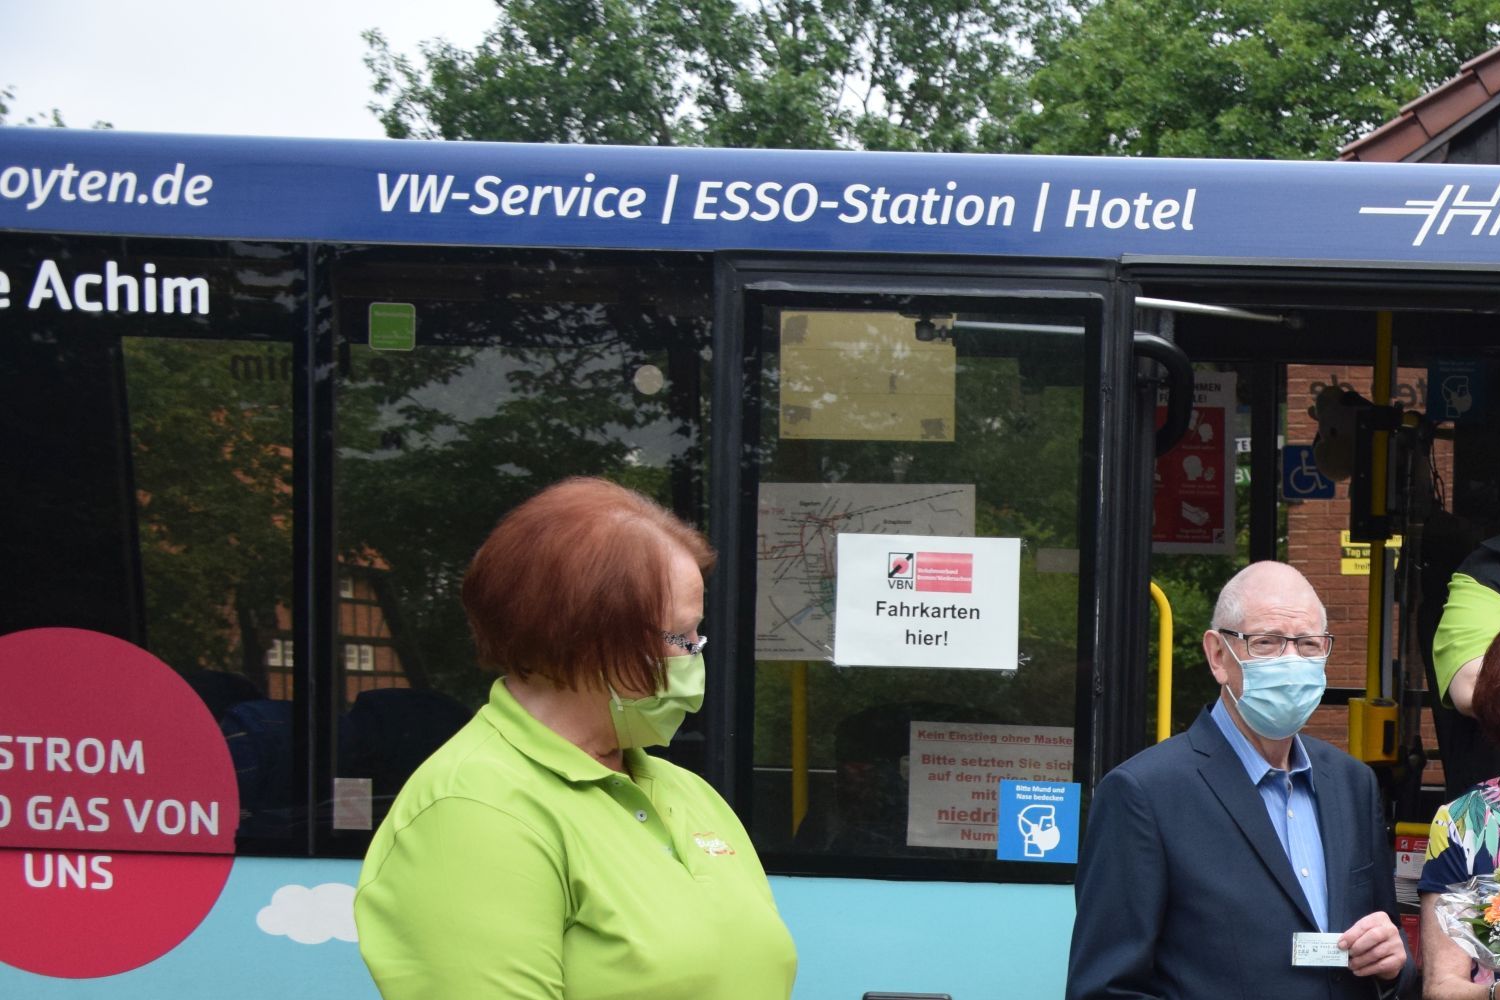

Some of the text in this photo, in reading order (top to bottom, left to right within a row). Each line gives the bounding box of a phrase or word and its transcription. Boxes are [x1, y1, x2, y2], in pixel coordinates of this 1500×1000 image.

[0, 162, 214, 211] oyten.de
[377, 172, 647, 220] VW-Service
[692, 180, 1017, 227] ESSO-Station
[1064, 187, 1197, 231] Hotel
[27, 258, 210, 315] Achim
[888, 579, 914, 590] VBN
[876, 600, 981, 620] Fahrkarten
[905, 629, 948, 646] hier!
[917, 729, 1073, 746] Kein Einstieg ohne Maske
[0, 735, 146, 775] STROM
[921, 753, 957, 766] Bitte
[960, 756, 1014, 769] setzten
[1018, 757, 1041, 770] Sie
[927, 770, 951, 782] auf
[955, 771, 982, 783] den
[971, 788, 998, 801] mit
[1015, 784, 1066, 794] Bitte Mund und
[1016, 793, 1065, 802] Nase bedecken
[26, 794, 110, 833] GAS
[122, 798, 220, 836] VON
[937, 806, 998, 823] niedri
[960, 828, 998, 842] Num
[24, 852, 114, 891] UNS
